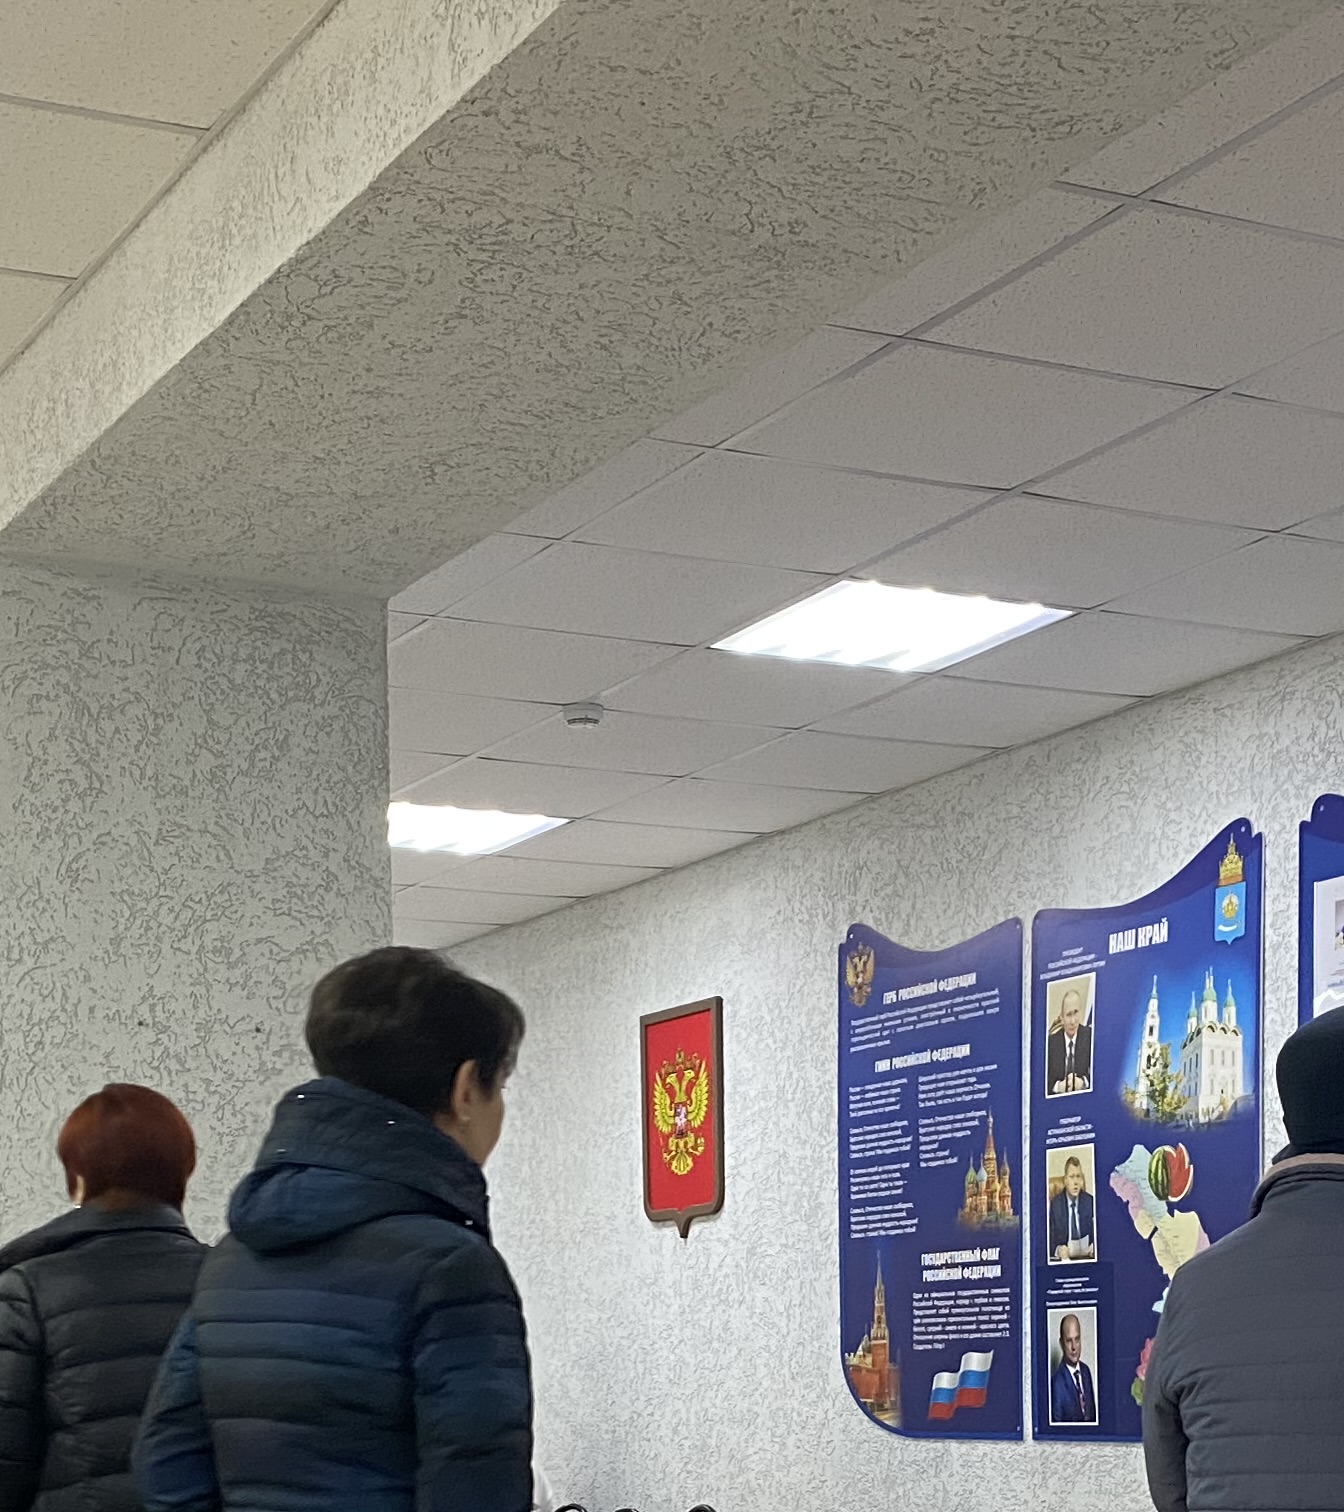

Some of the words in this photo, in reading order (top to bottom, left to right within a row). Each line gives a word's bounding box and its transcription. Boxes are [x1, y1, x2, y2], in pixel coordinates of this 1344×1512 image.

[1109, 929, 1136, 954] НАШ
[1137, 917, 1169, 948] КРАЙ
[898, 979, 937, 1001] РОССИЙСКОЙ
[938, 972, 976, 992] ФЕДЕРАЦИИ
[932, 1043, 970, 1062] ФЕДЕРАЦИИ
[921, 1247, 981, 1266] ГОСУДАРСТВЕННЫЙ
[962, 1264, 1002, 1280] ФЕДЕРАЦИИ
